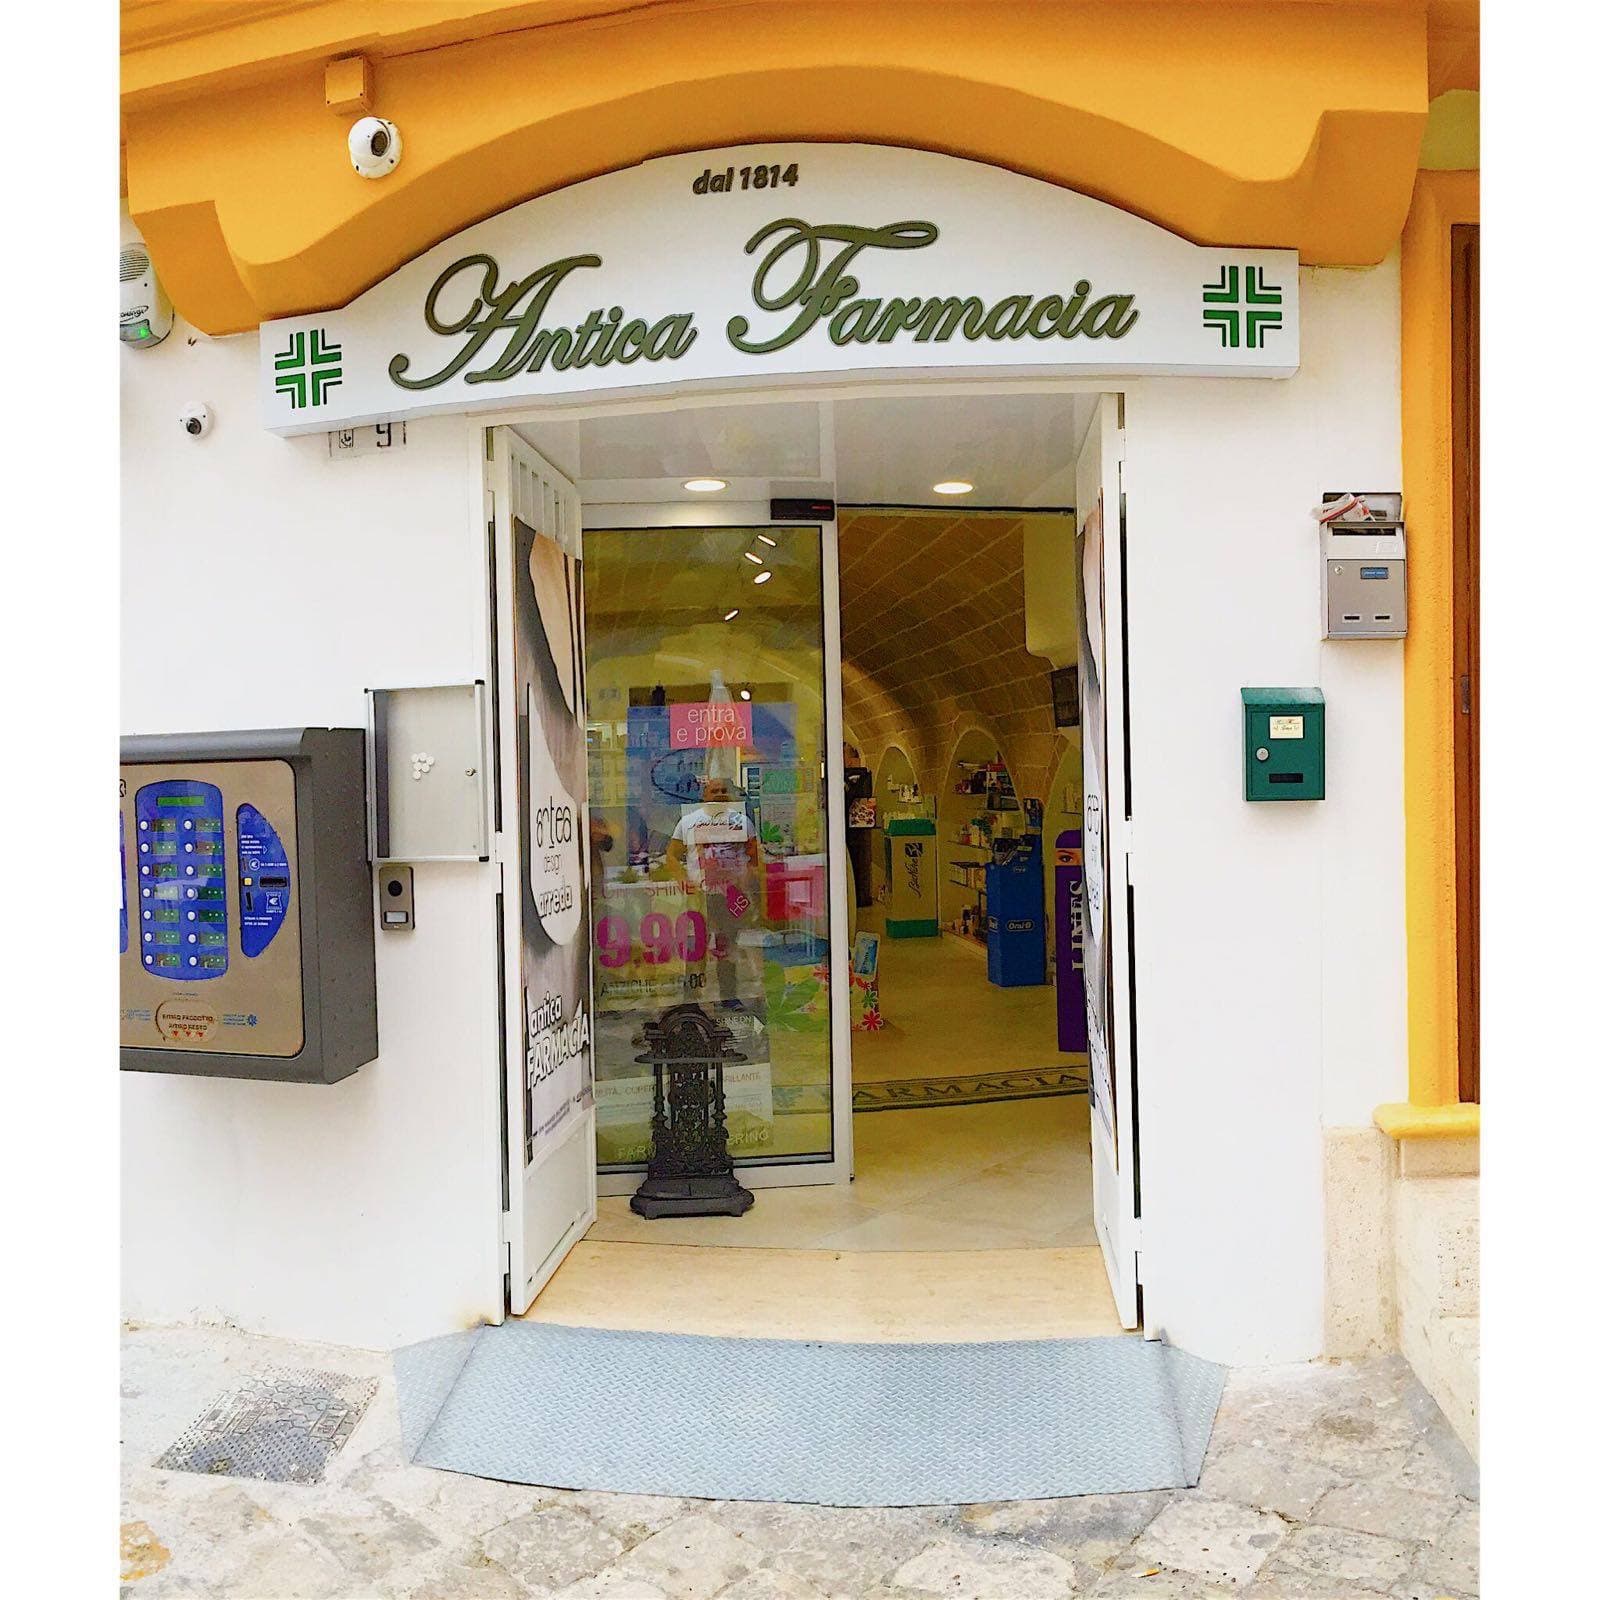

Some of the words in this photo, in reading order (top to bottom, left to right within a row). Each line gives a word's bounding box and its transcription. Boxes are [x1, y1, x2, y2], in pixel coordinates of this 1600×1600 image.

[692, 167, 735, 194] dal
[740, 163, 799, 190] 1814
[387, 253, 701, 391] Antica
[725, 217, 1139, 355] Farmacia
[687, 704, 735, 724] entra
[676, 728, 688, 742] e
[695, 725, 747, 746] prova
[729, 894, 751, 918] HS
[595, 910, 708, 969] 9.90
[529, 991, 563, 1038] antica
